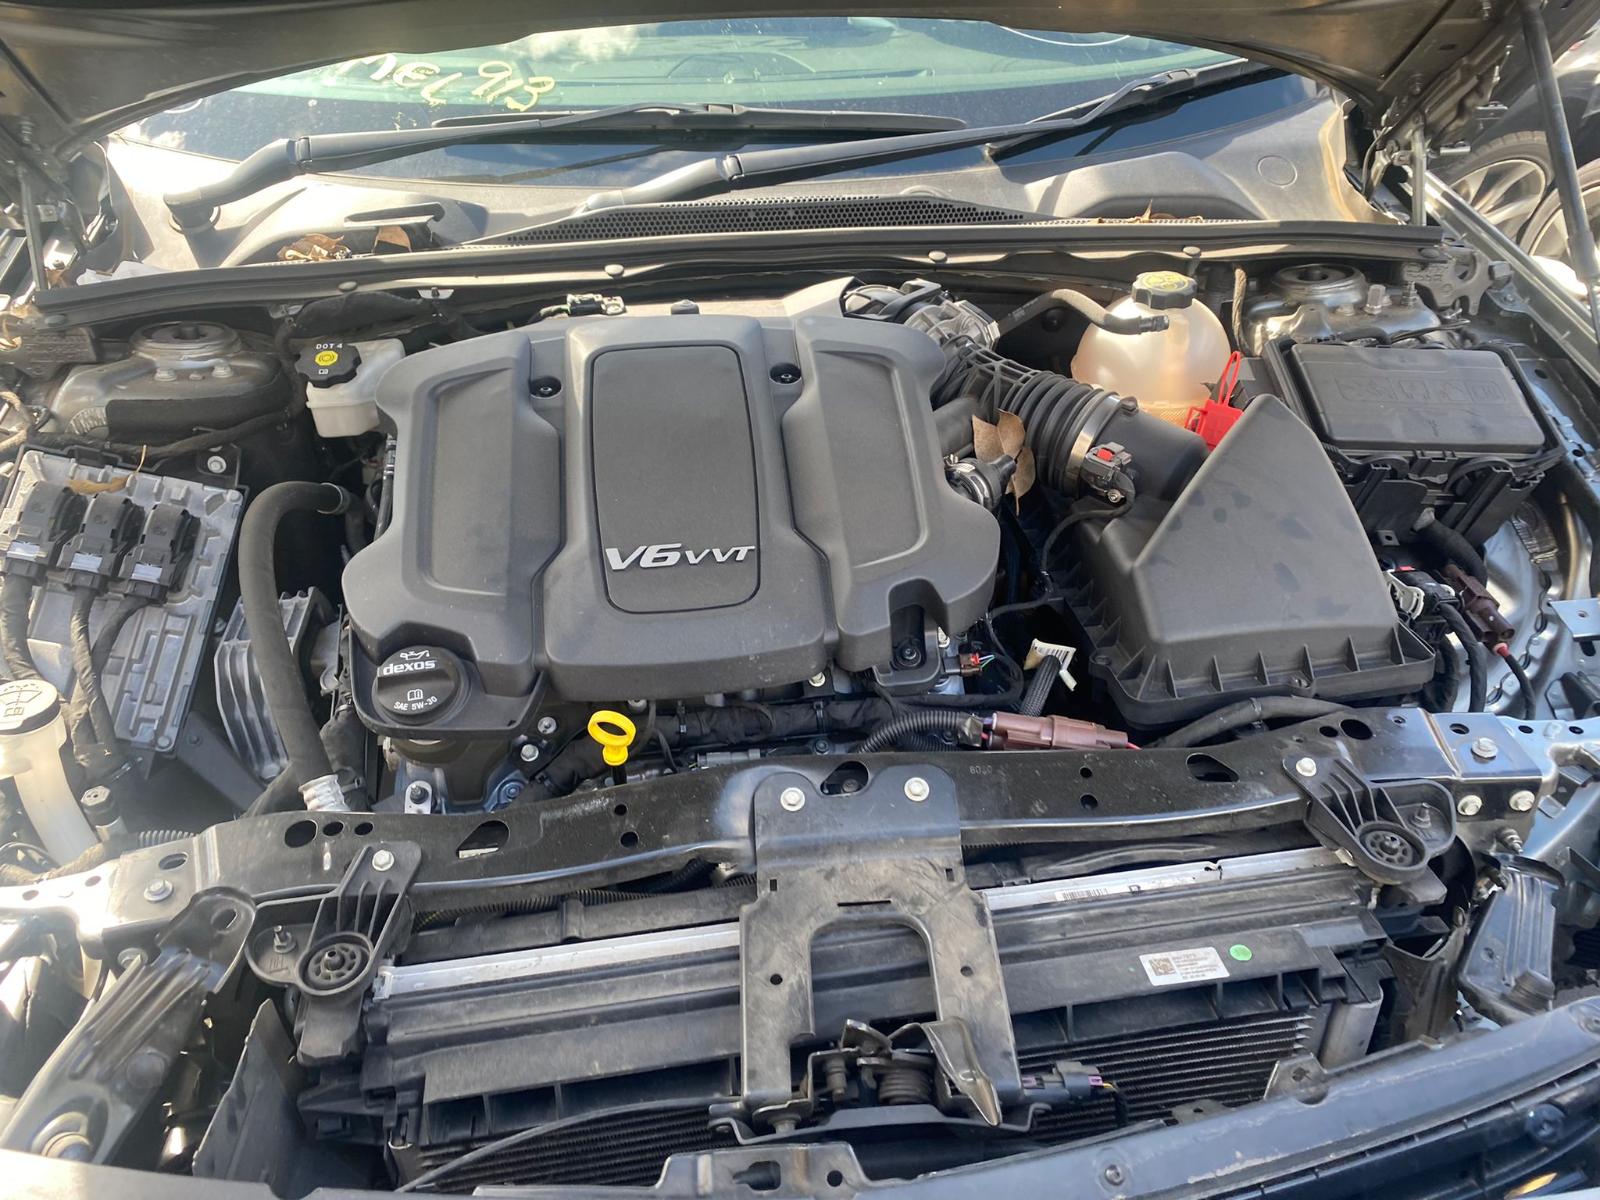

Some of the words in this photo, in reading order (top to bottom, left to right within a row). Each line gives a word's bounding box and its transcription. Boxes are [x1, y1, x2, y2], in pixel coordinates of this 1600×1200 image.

[605, 543, 682, 571] V6
[685, 545, 756, 565] VVT
[382, 660, 437, 676] dexos
[393, 701, 409, 711] SAE
[411, 696, 438, 711] 5W-30
